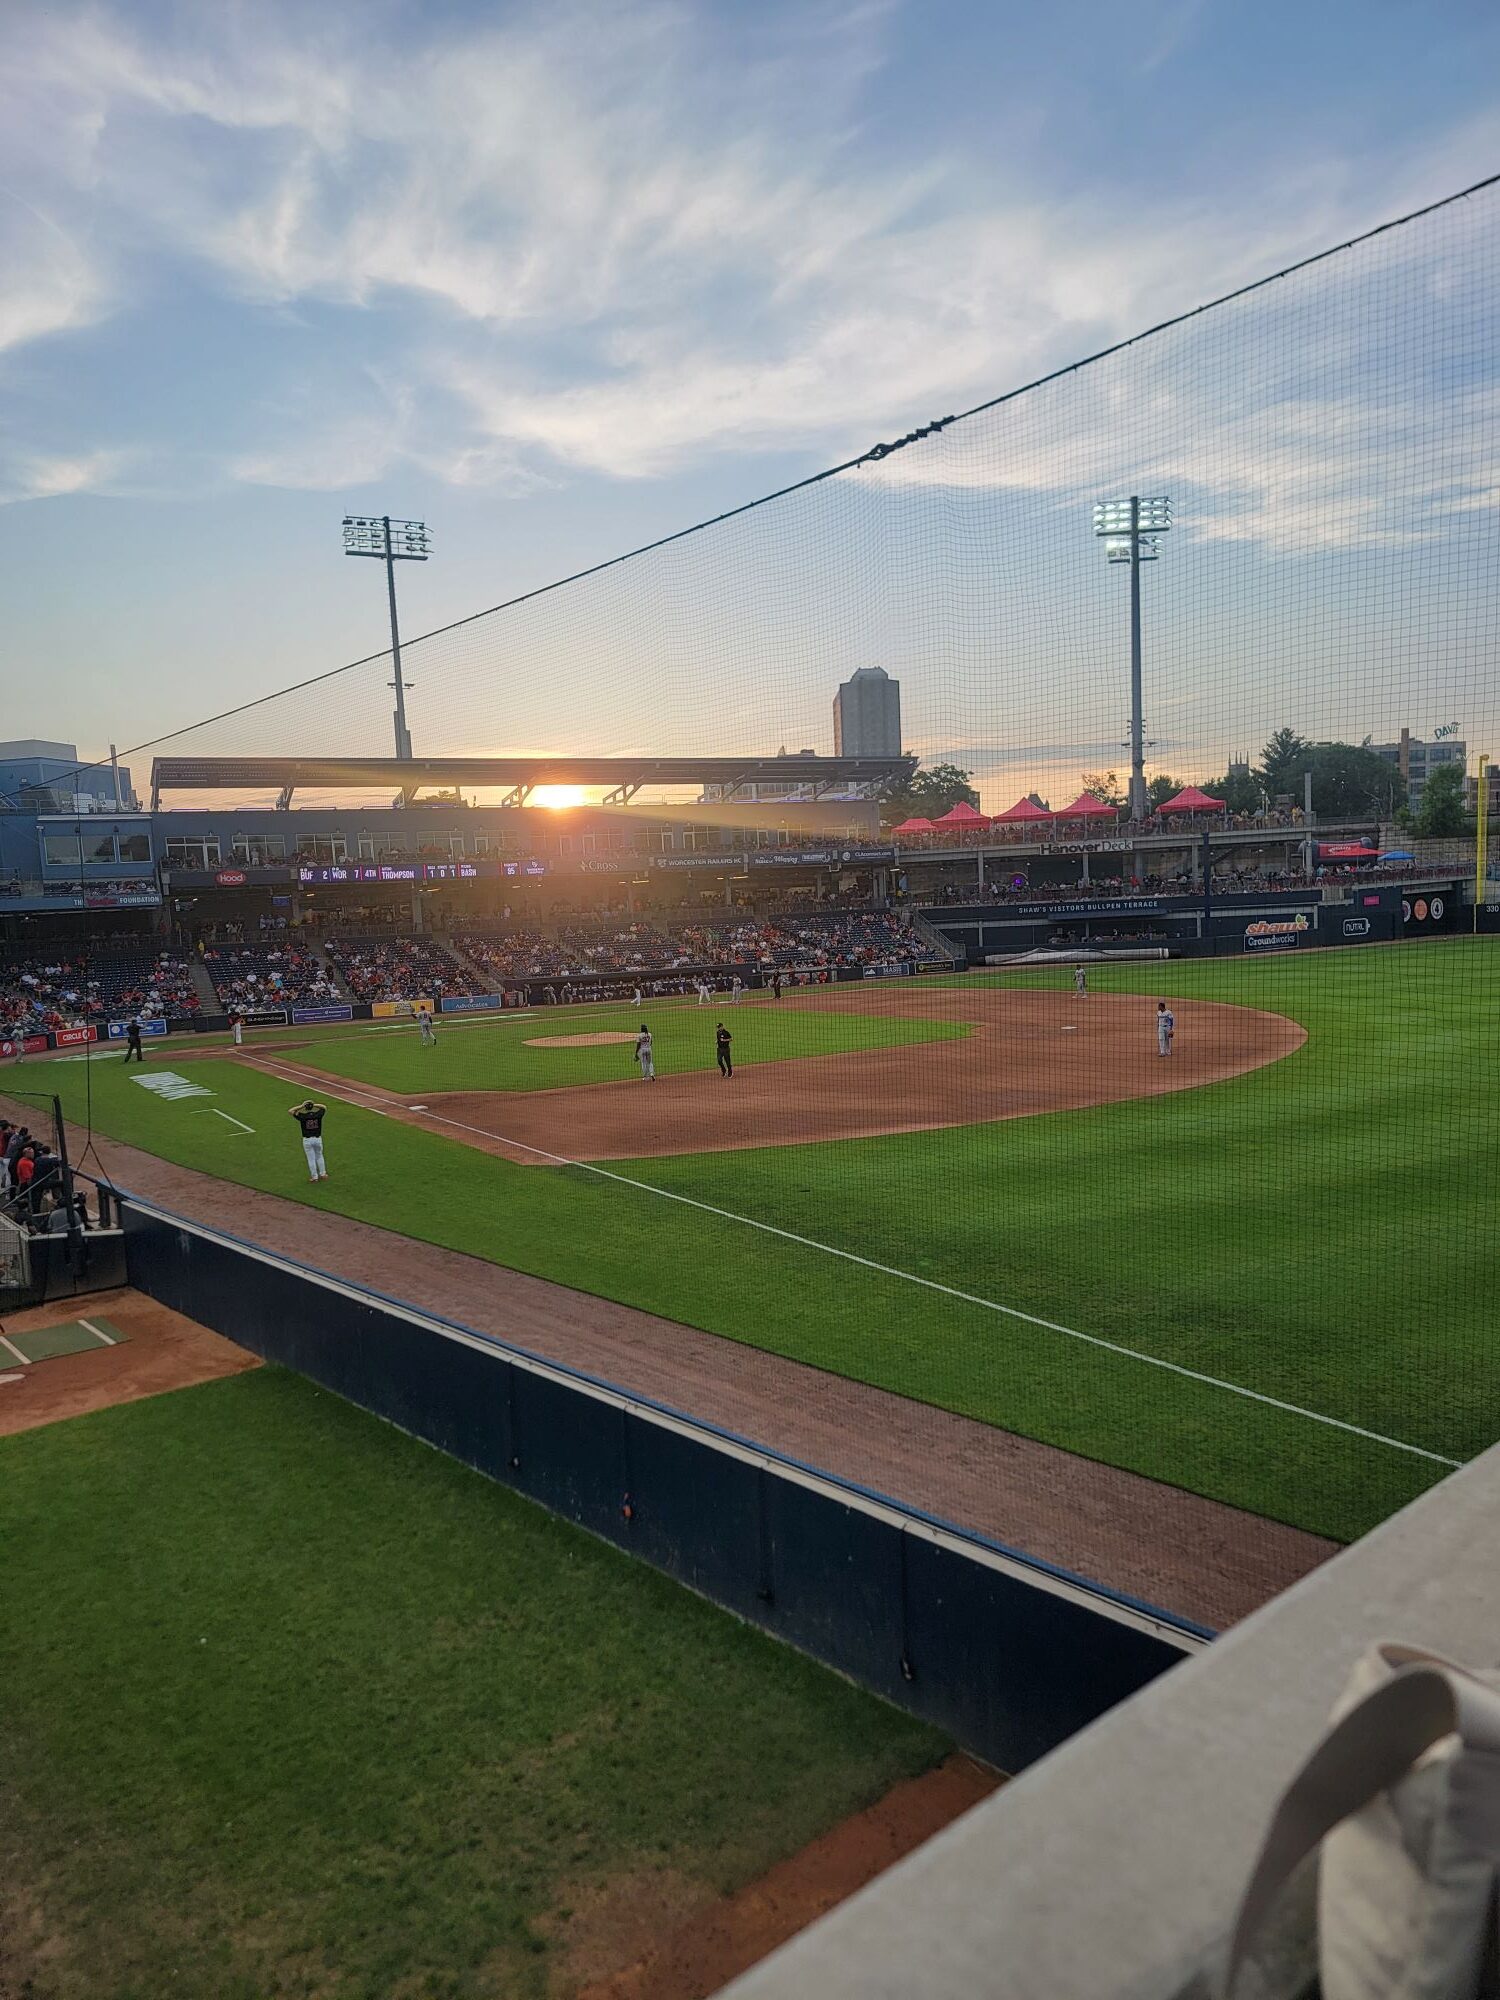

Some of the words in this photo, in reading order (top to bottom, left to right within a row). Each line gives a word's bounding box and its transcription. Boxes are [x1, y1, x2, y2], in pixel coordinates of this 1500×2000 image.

[1041, 841, 1100, 854] Hanover
[1101, 840, 1132, 851] Deck
[669, 859, 705, 867] WORCESTER
[322, 870, 328, 880] 2
[332, 870, 348, 879] WOR
[354, 869, 359, 878] 7
[364, 869, 377, 878] 4TH
[382, 871, 415, 880] THOMPSON
[440, 870, 445, 878] 0
[460, 868, 477, 877] BASH
[220, 873, 244, 883] Hood
[119, 896, 160, 904] FOUNDATION
[1018, 906, 1047, 914] SHAW'S
[1049, 904, 1085, 913] VISITORS
[1087, 903, 1121, 911] BULLPEN
[1123, 900, 1158, 908] TERRACE
[1486, 905, 1500, 913] 330
[1248, 934, 1296, 947] Groundworks
[62, 1032, 82, 1042] CIRCLE
